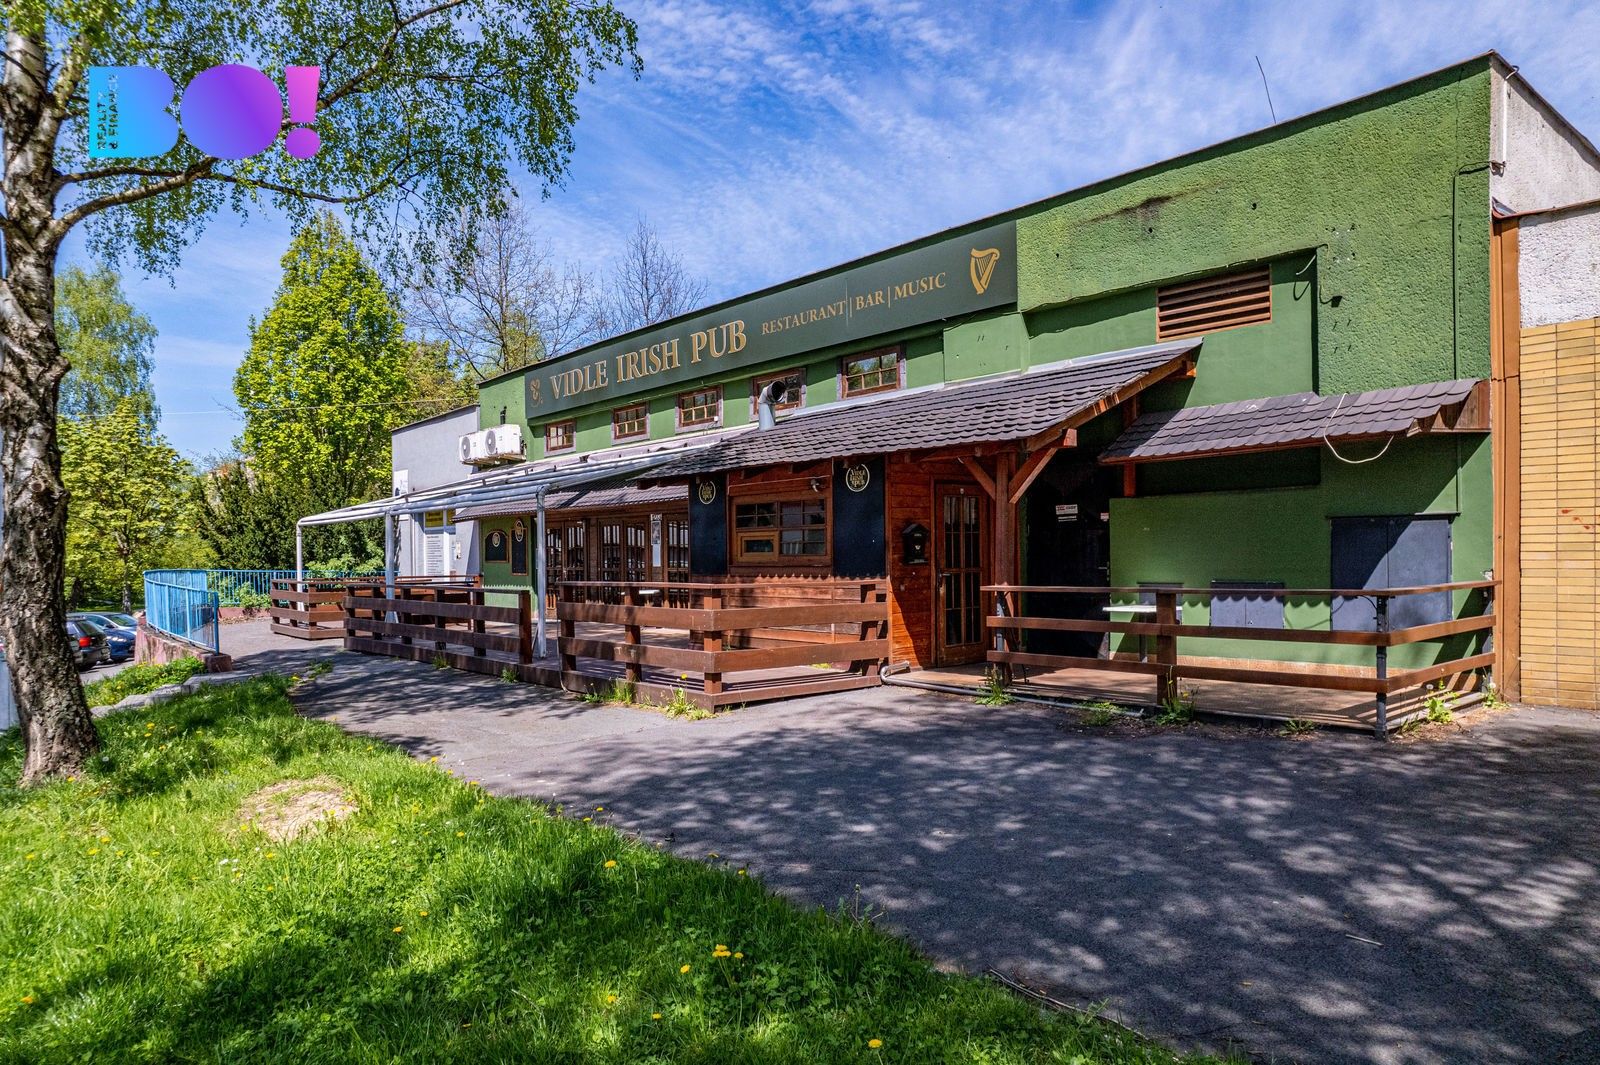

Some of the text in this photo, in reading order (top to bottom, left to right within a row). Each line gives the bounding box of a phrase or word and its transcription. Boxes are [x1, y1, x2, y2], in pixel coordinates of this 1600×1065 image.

[761, 272, 947, 335] RESTAURANT BAR MUSIC
[550, 319, 747, 399] VIDLE IRISH PUB
